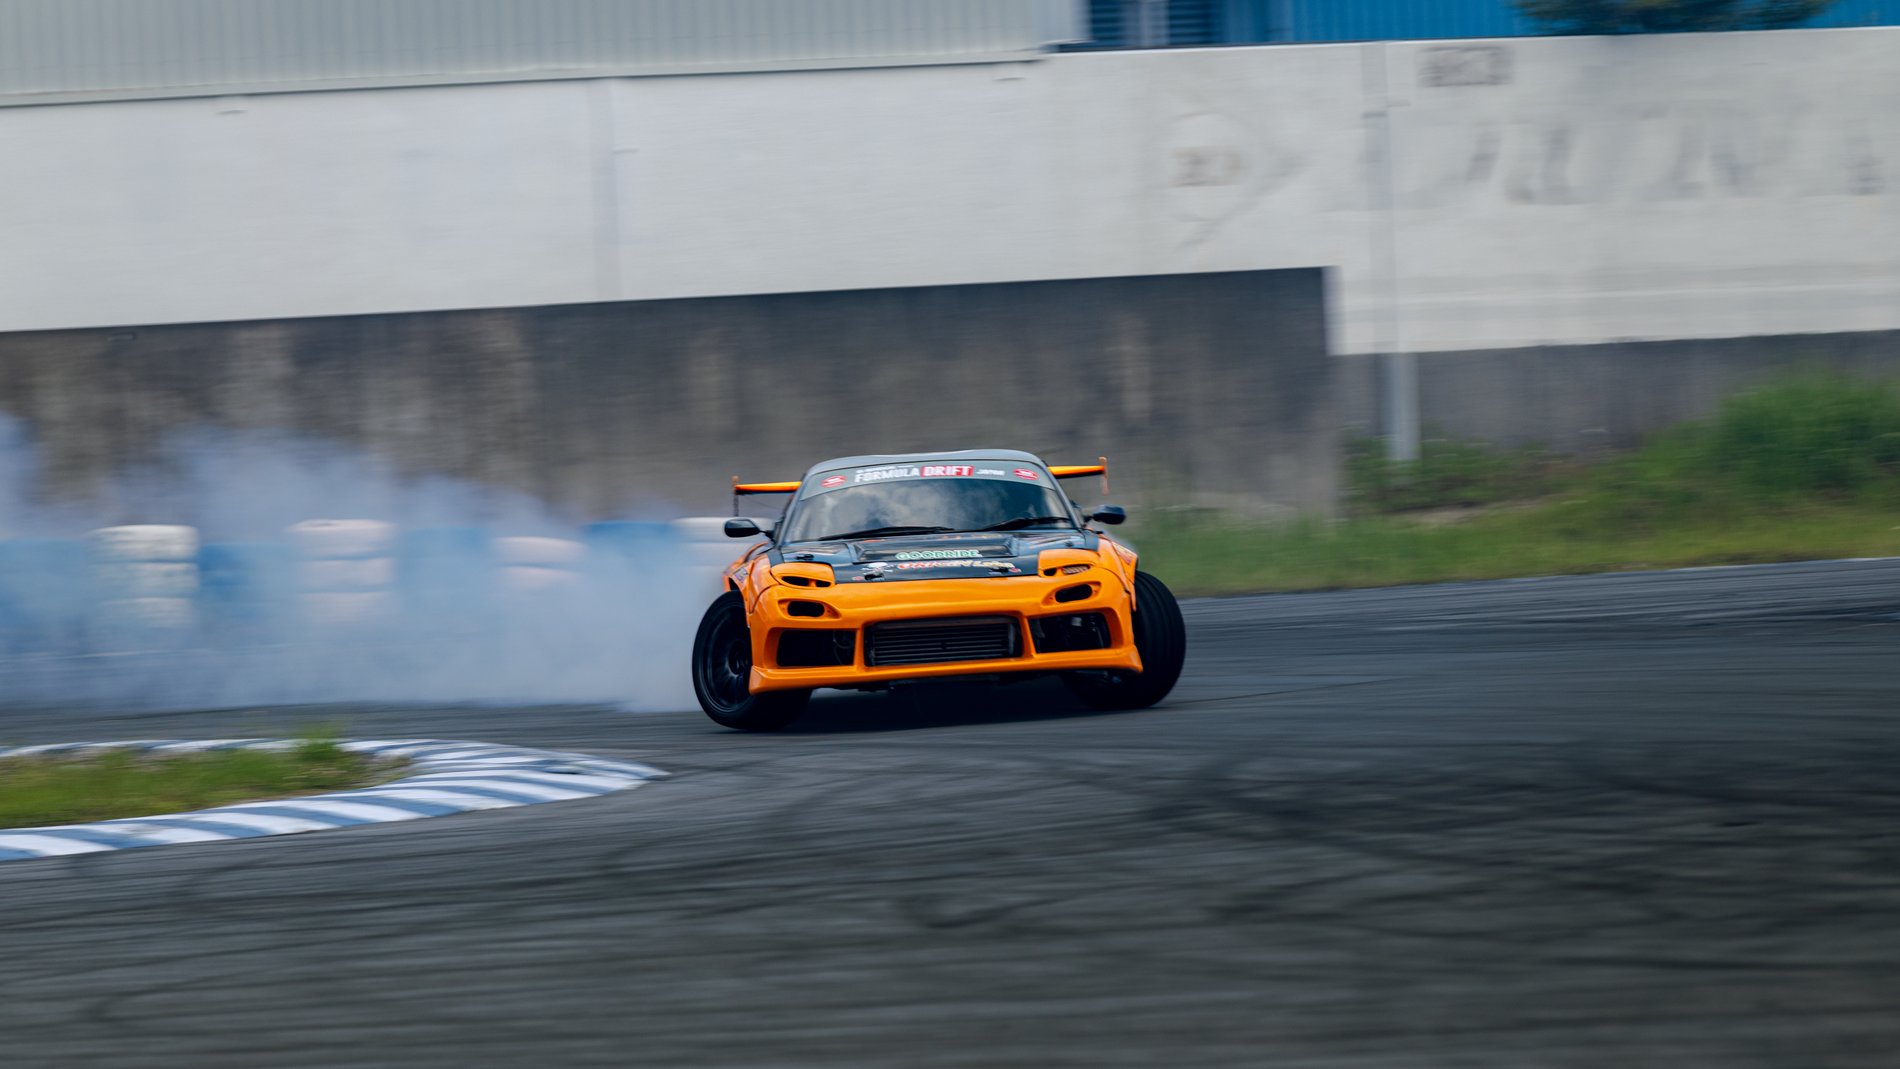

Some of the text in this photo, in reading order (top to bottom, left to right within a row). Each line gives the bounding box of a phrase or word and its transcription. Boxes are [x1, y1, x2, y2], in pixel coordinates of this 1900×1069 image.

[854, 467, 920, 483] FORMULA
[923, 465, 973, 477] DRIFT
[895, 549, 981, 561] GOODRIDE
